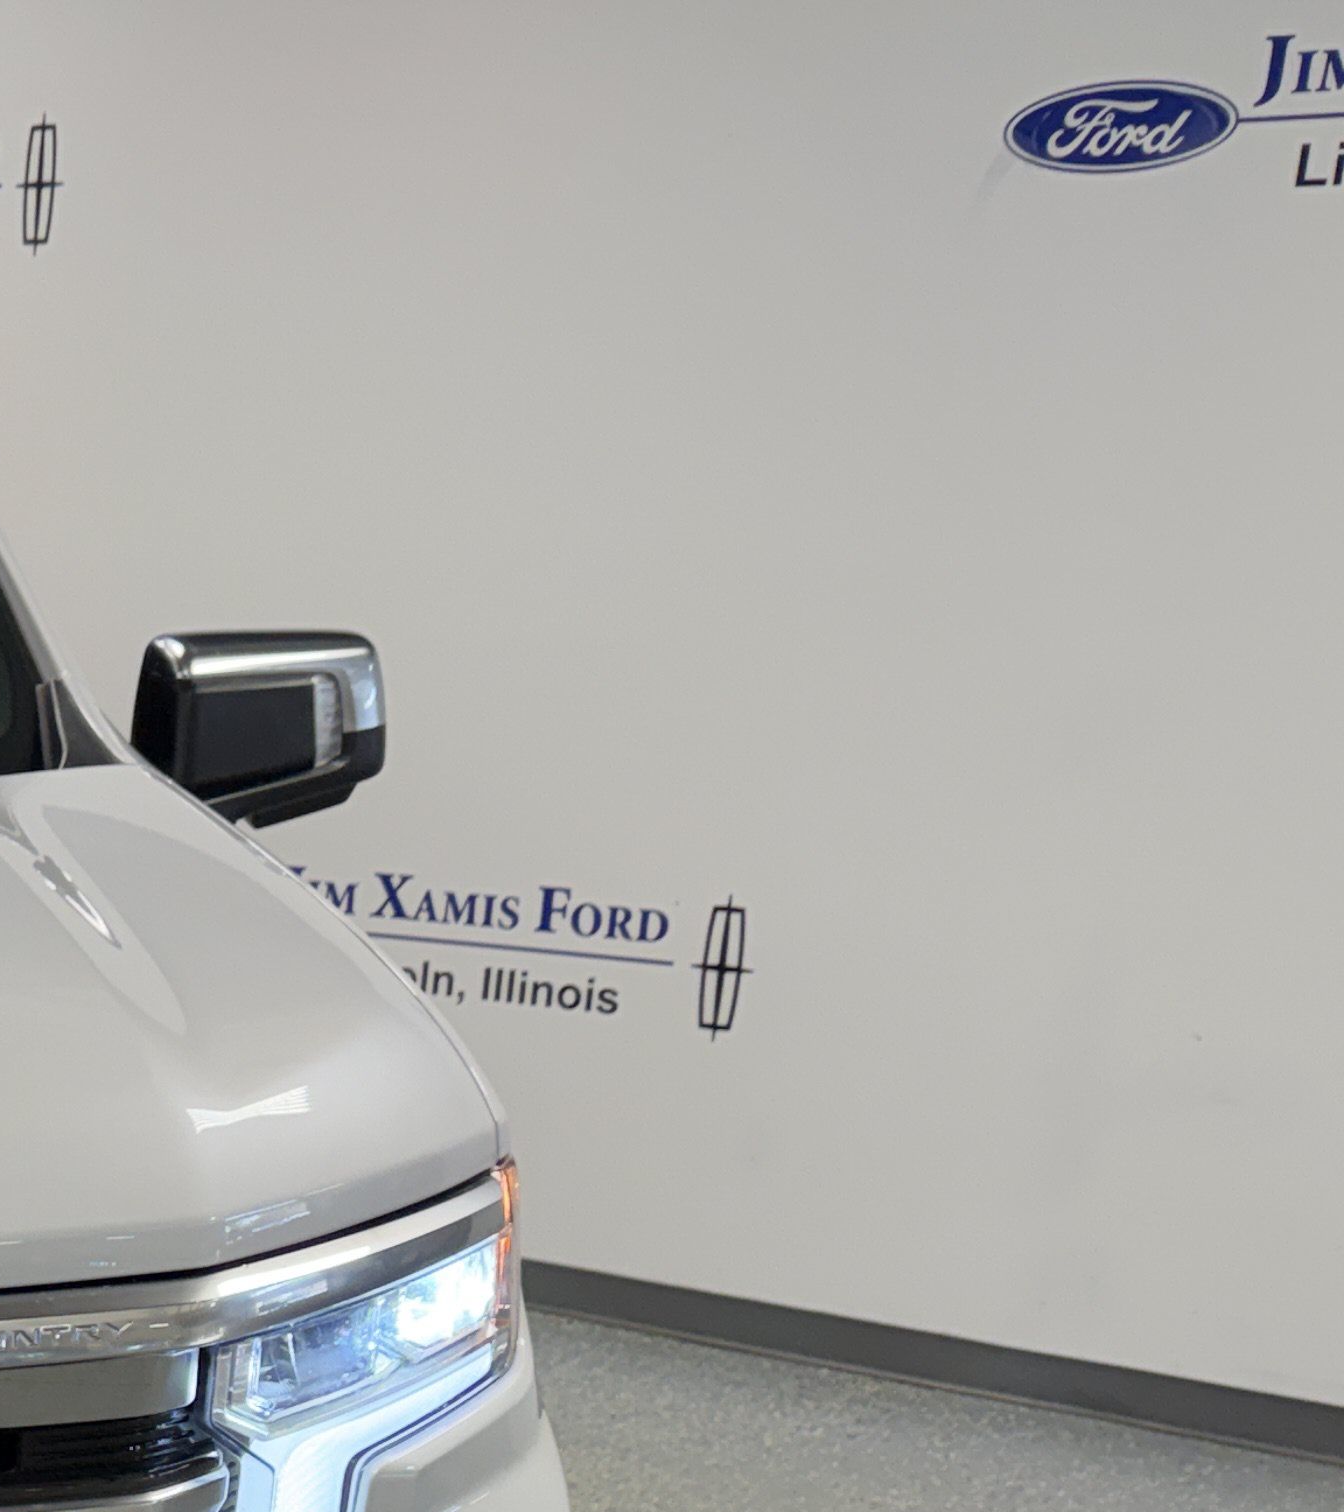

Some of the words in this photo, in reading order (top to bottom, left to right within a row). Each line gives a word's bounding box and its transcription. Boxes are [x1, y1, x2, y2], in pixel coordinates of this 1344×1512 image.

[1046, 98, 1193, 159] Ford
[368, 871, 521, 932] XAMIS
[534, 885, 670, 944] FORD
[480, 965, 620, 1016] Illinois
